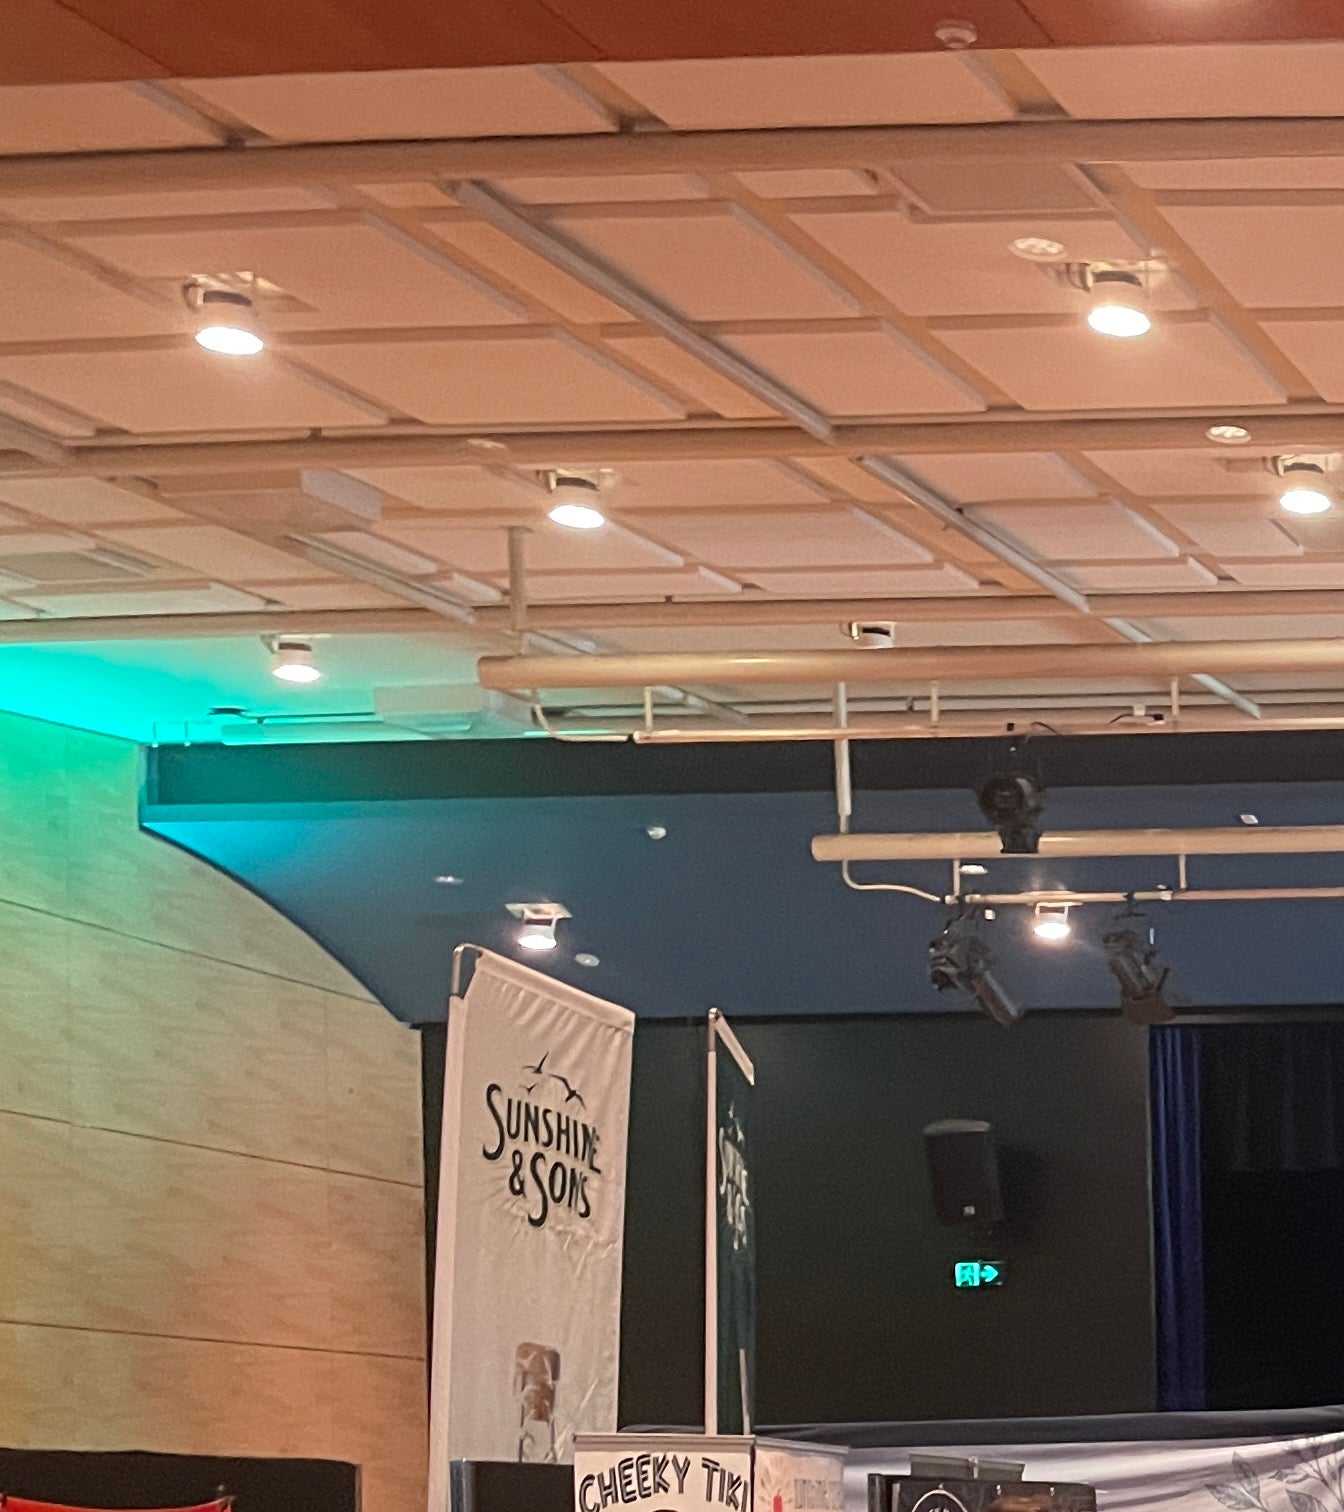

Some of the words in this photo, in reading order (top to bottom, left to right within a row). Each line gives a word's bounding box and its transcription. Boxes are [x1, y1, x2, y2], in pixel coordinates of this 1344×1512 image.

[483, 1083, 601, 1174] SUNSHINE
[509, 1150, 526, 1199] &
[528, 1152, 591, 1227] SONS
